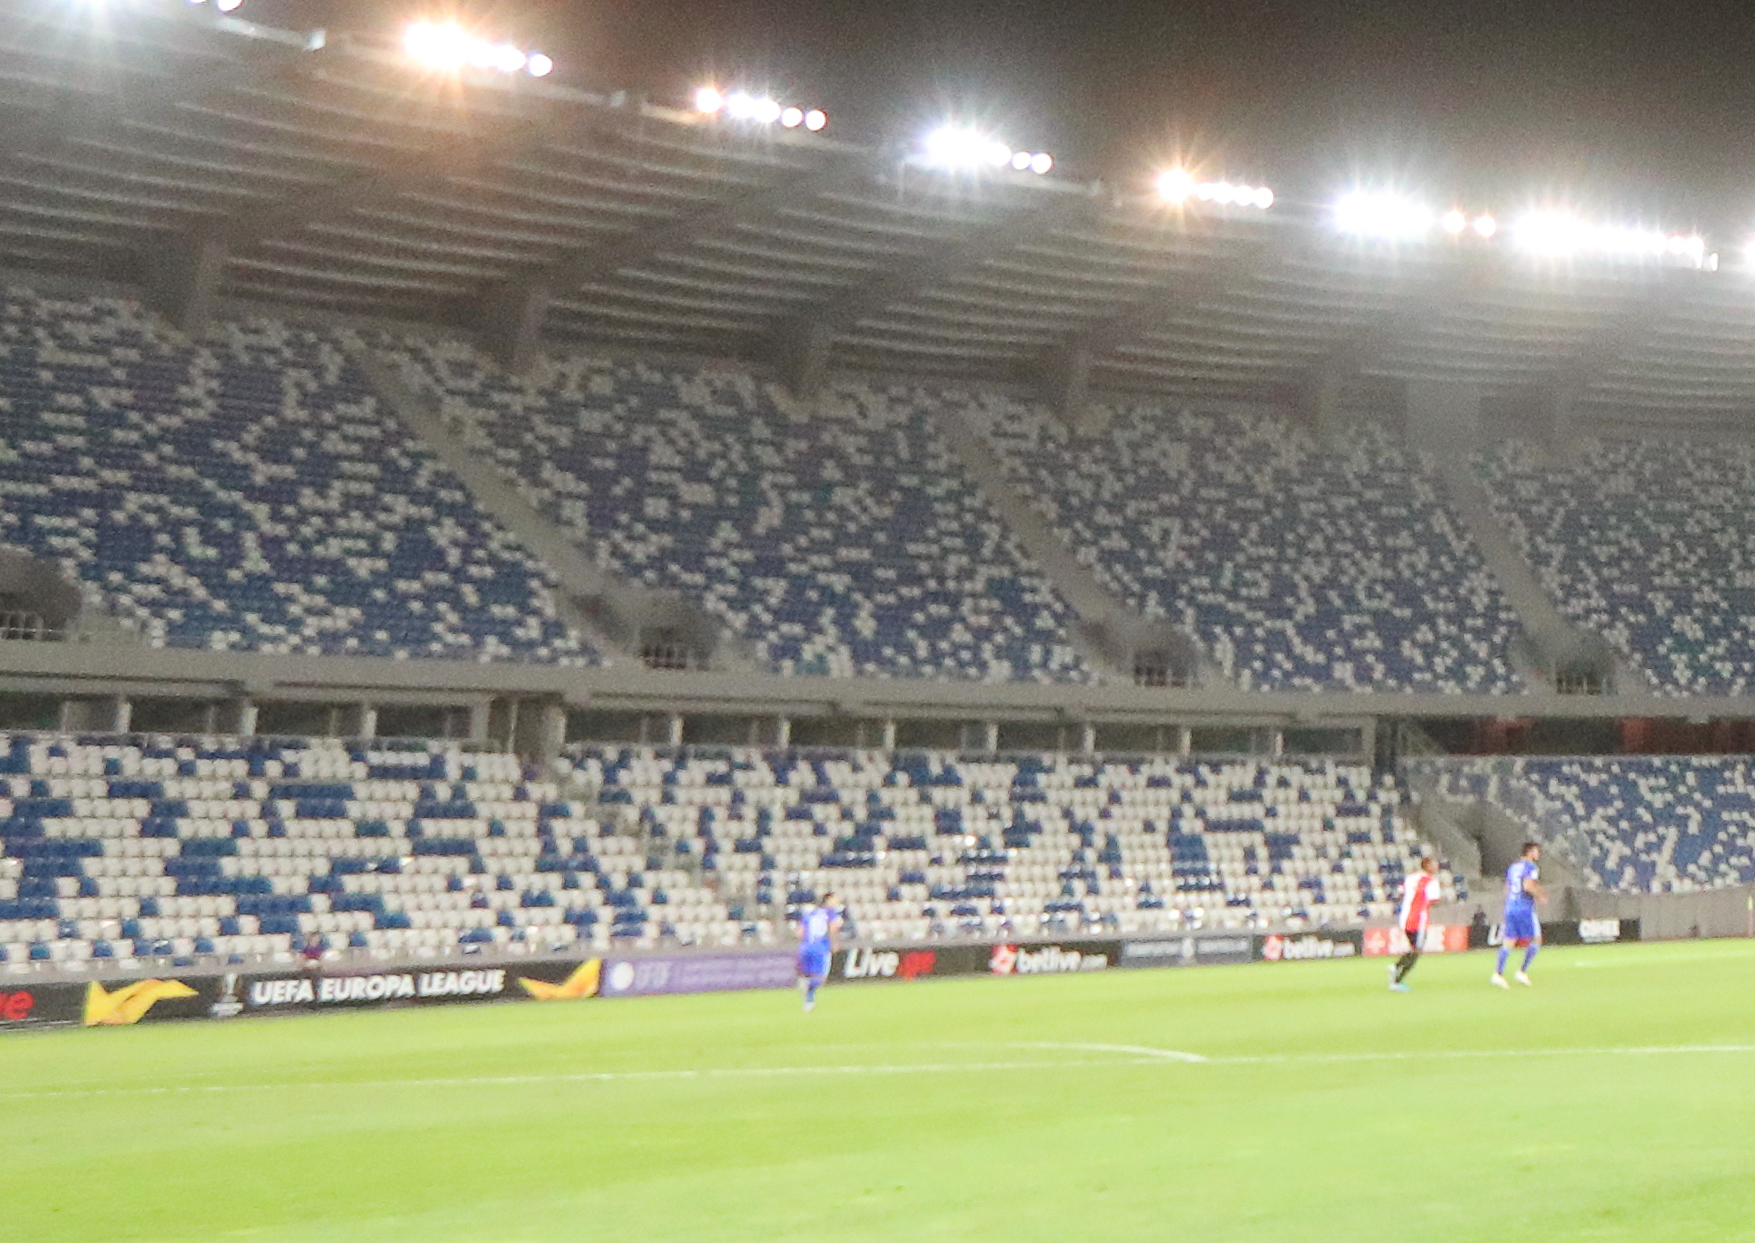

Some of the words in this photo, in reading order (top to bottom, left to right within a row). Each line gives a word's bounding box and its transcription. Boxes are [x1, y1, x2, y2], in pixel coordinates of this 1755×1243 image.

[253, 978, 315, 1004] UEFA
[318, 974, 416, 1002] EUROPA
[419, 969, 506, 996] LEAGUE
